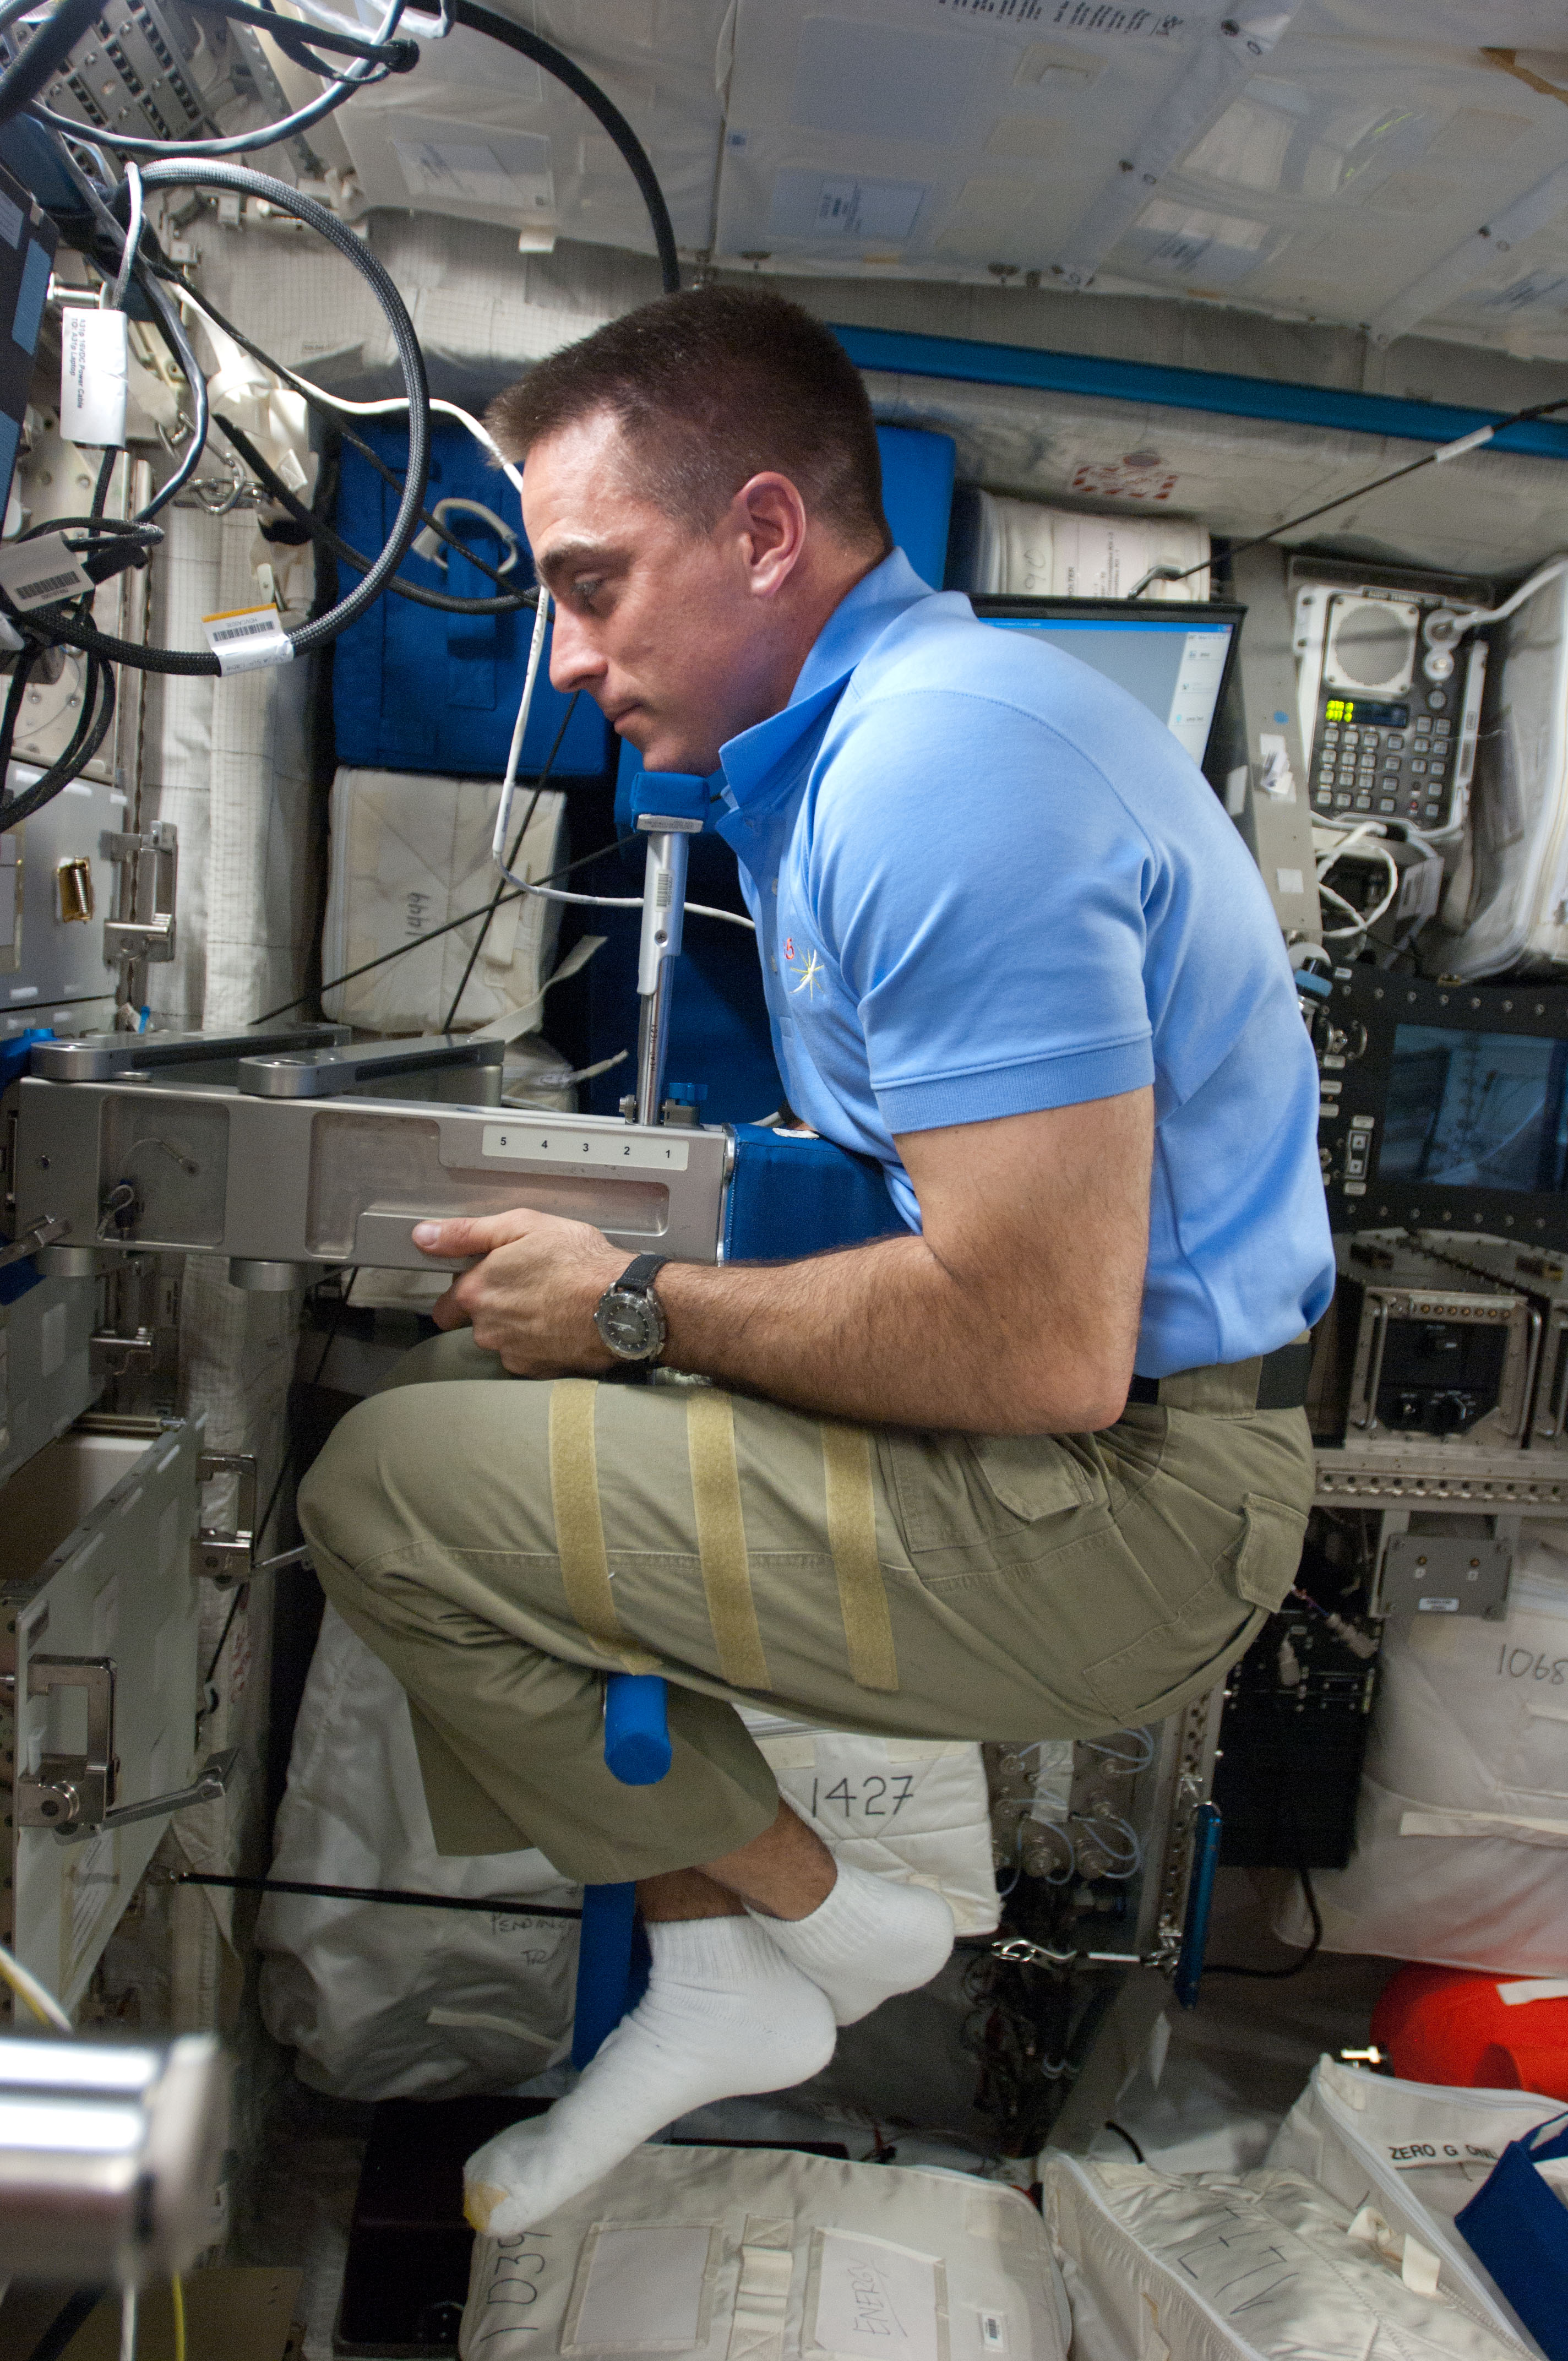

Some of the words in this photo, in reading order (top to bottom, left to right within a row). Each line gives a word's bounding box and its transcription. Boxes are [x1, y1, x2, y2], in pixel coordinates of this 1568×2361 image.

[783, 938, 794, 960] 5
[500, 1136, 507, 1146] 5
[542, 1140, 548, 1149] 4
[582, 1143, 589, 1152] 3
[623, 1146, 630, 1155] 2
[665, 1149, 671, 1158] 1
[812, 1775, 915, 1818] 1427
[1387, 2144, 1436, 2160] ZERO
[1442, 2144, 1458, 2157] G
